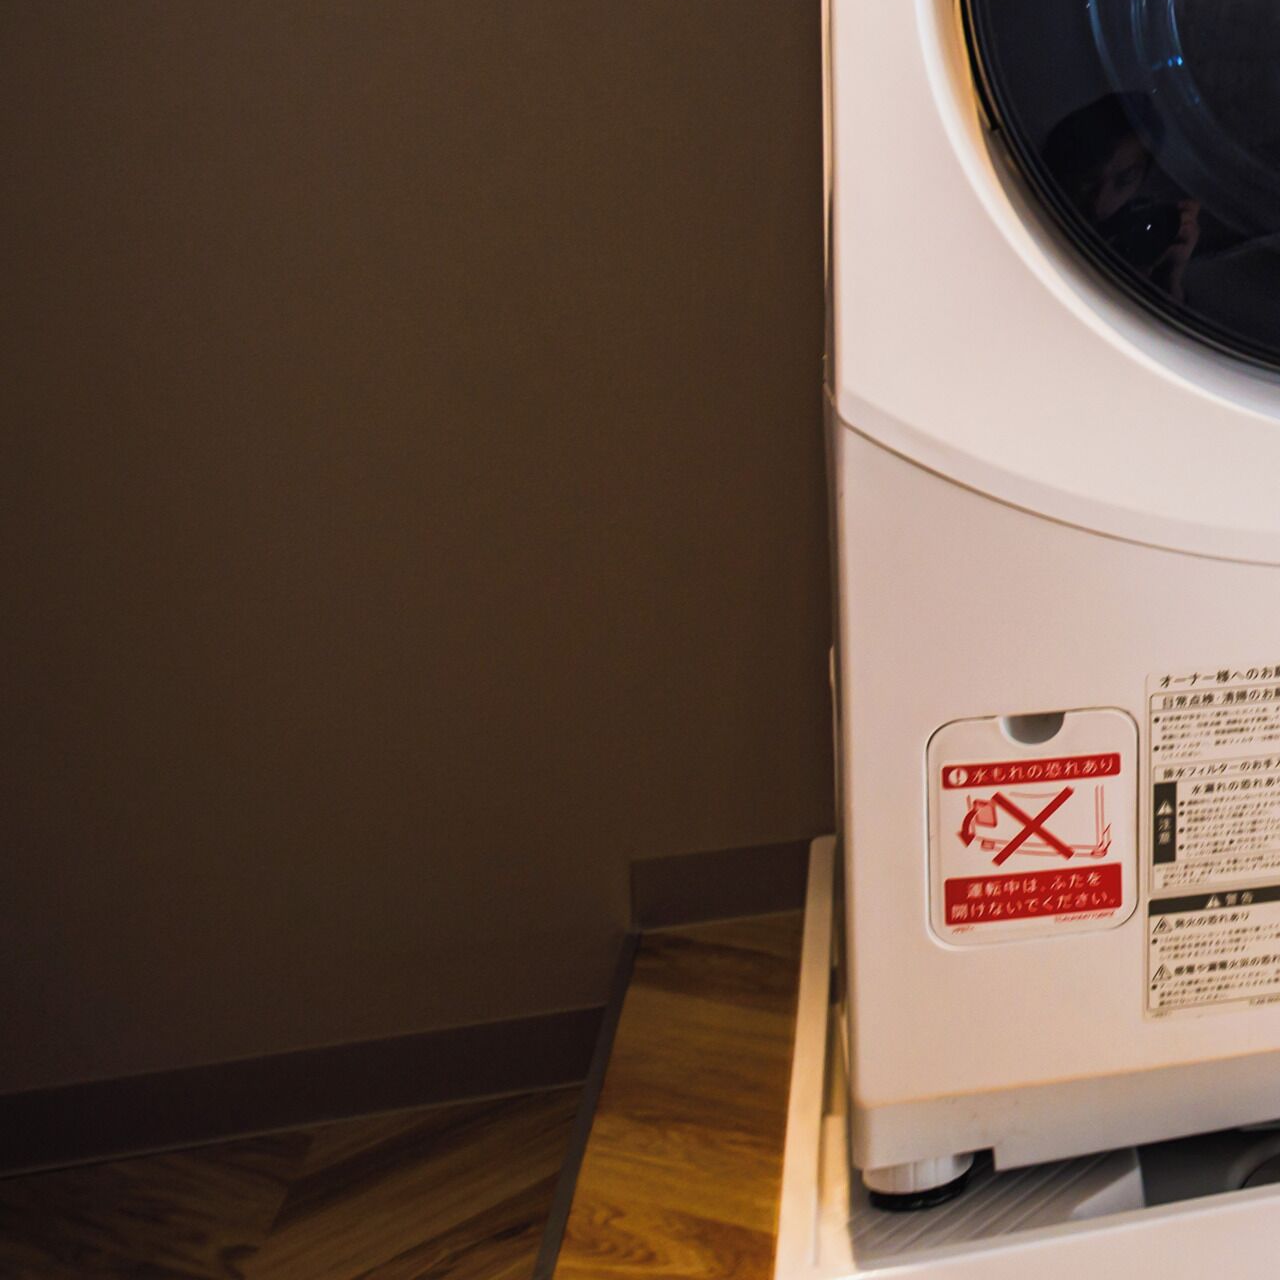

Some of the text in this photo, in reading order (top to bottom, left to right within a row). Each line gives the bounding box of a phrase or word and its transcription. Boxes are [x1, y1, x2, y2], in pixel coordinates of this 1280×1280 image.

[972, 757, 1114, 785] 水もれの恐れあり
